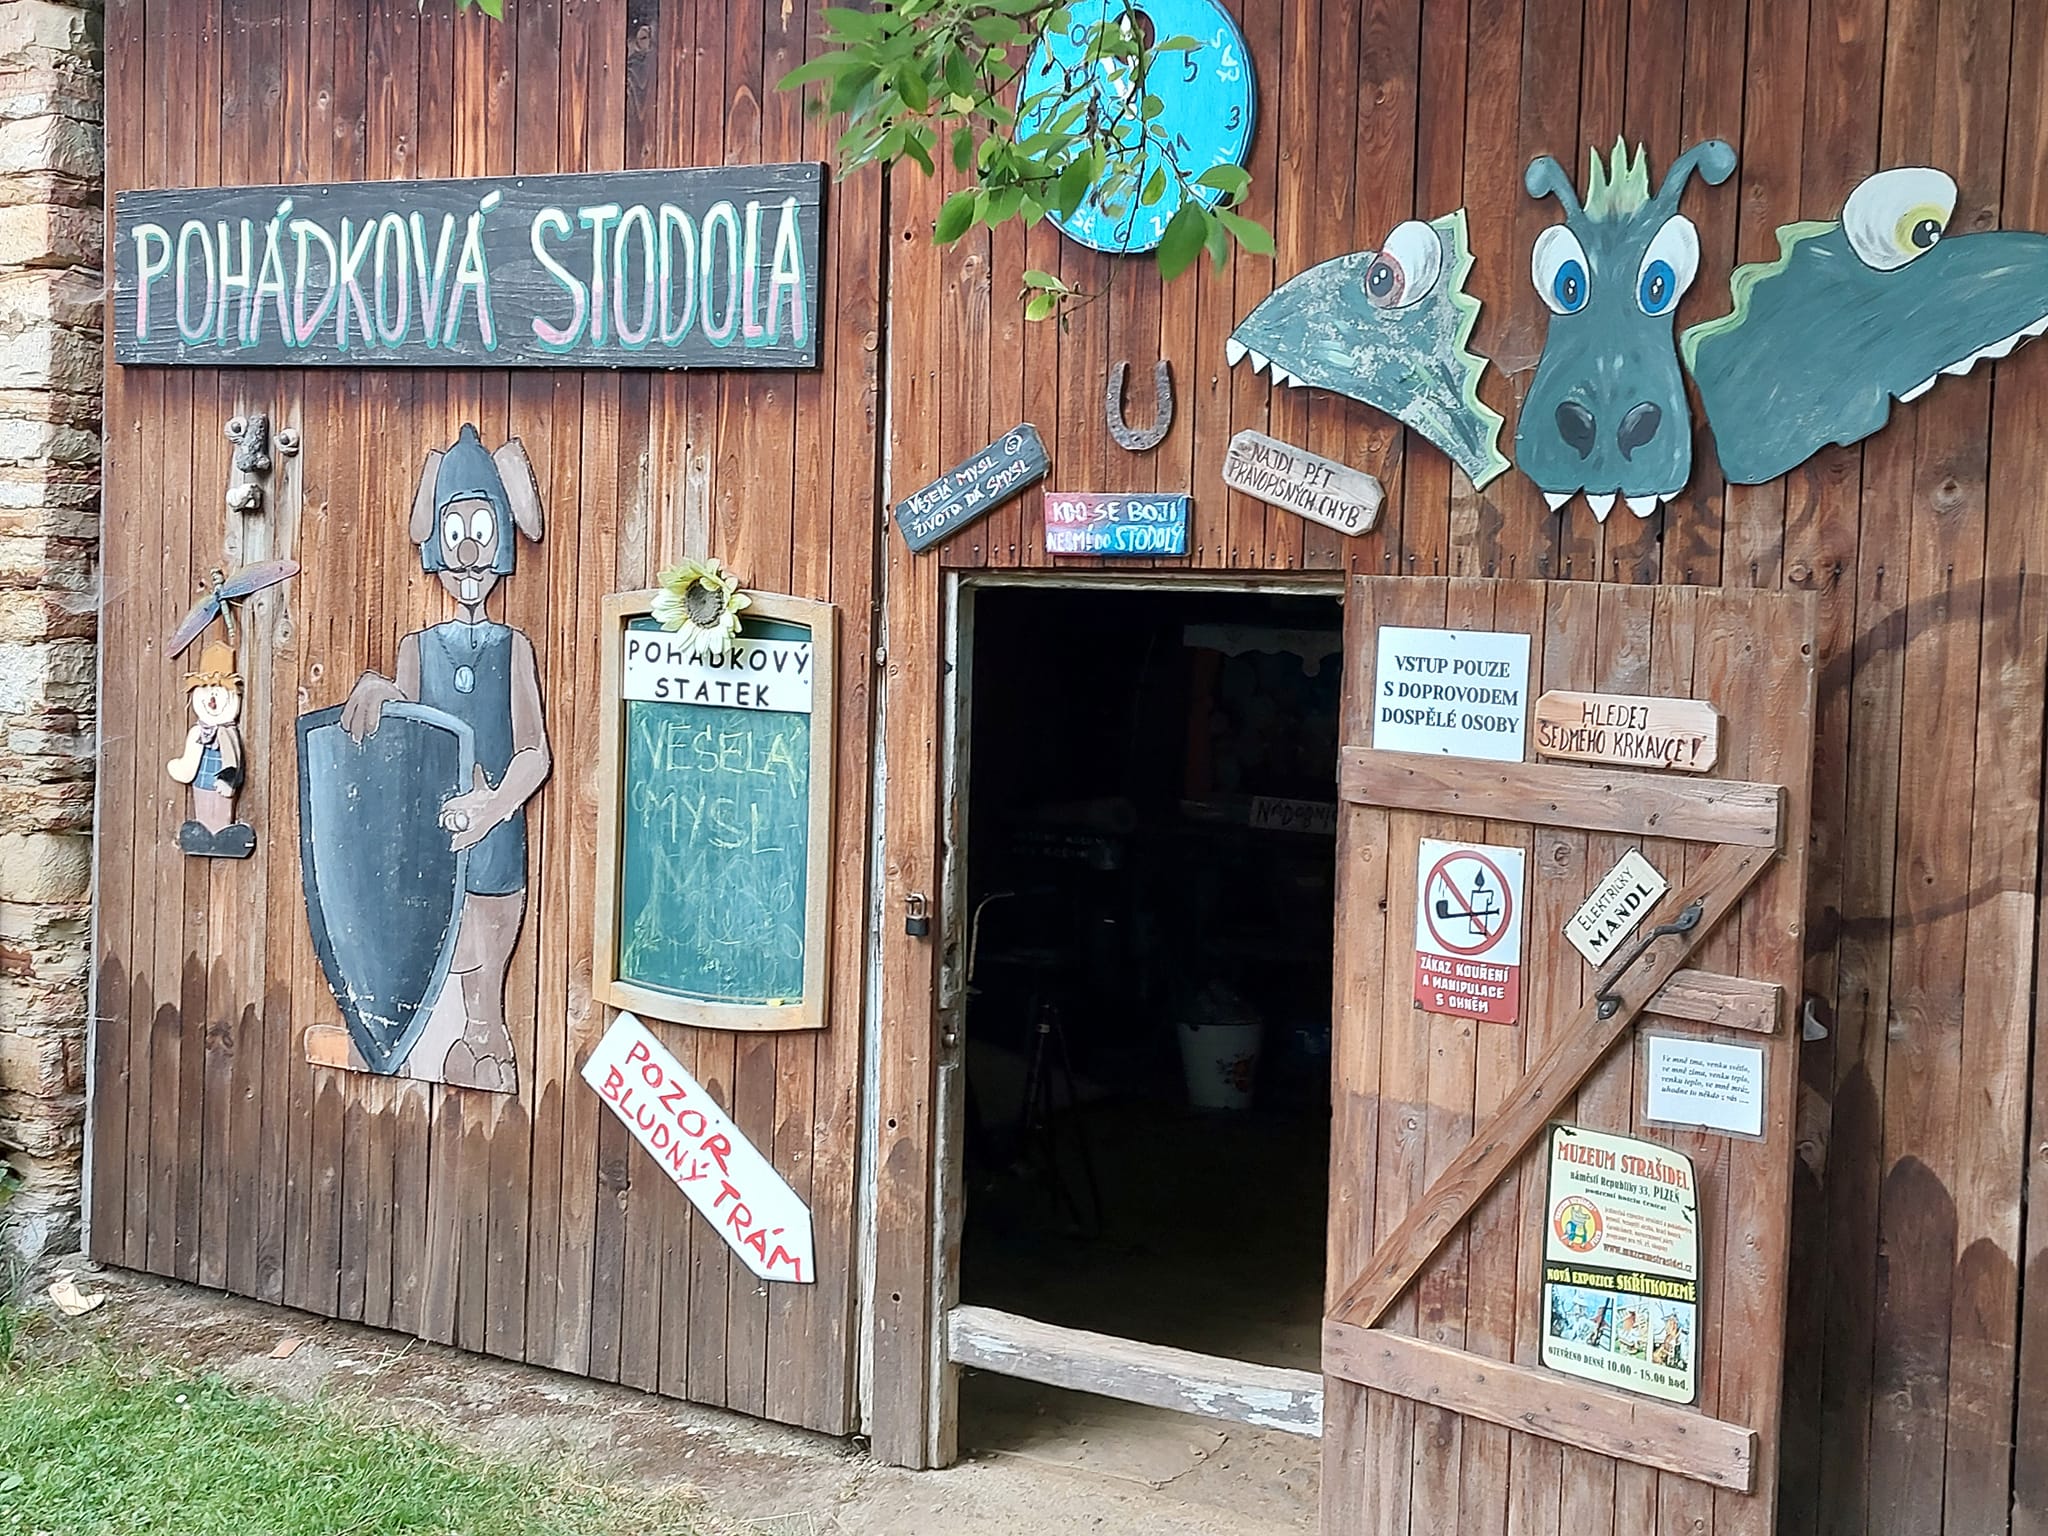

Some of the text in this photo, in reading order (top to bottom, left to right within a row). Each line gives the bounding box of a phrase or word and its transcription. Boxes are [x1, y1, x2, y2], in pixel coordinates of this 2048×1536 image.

[1223, 106, 1241, 131] 3
[131, 189, 809, 354] POHÁDKOVÁ STODOLA
[1250, 442, 1295, 475] NAJDI
[906, 478, 954, 516] VESELÁ
[955, 455, 1000, 487] MYSL
[963, 483, 986, 509] DÁ
[986, 459, 1033, 498] SMYSL
[1228, 457, 1360, 528] PRAVOPISNÝCH CHYB
[1053, 497, 1182, 523] KDO SE BOJÍ
[1394, 655, 1511, 678] VSTUP POUZE
[655, 677, 770, 707] STATEK
[1384, 681, 1519, 706] S DOPROVODEM
[1382, 706, 1520, 734] DOSPĚLÉ OSOBY
[1582, 701, 1650, 730] HLEDEJ
[1588, 882, 1655, 954] MANDL
[1420, 954, 1511, 983] ZÁKAZ KOUŘENÍ
[1422, 974, 1505, 999] A MANIPULACE
[1435, 993, 1489, 1013] S OHNĚM
[625, 1040, 733, 1178] POZOR
[598, 1064, 802, 1282] BLUDNÝ TRÁM
[1557, 1141, 1690, 1191] MUZEUM STRAŠIDEL
[1570, 1172, 1599, 1185] náměstí
[1600, 1177, 1638, 1195] Republiky
[1653, 1184, 1680, 1205] PLZEŇ
[1546, 1268, 1696, 1302] NOVÁ EXPOZICE SKŘÍTKOZEMĚ
[1548, 1346, 1582, 1362] OTEVŘENO
[1583, 1354, 1605, 1369] DENNĚ
[1607, 1359, 1632, 1376] 10.00
[1668, 1375, 1689, 1391] hod.
